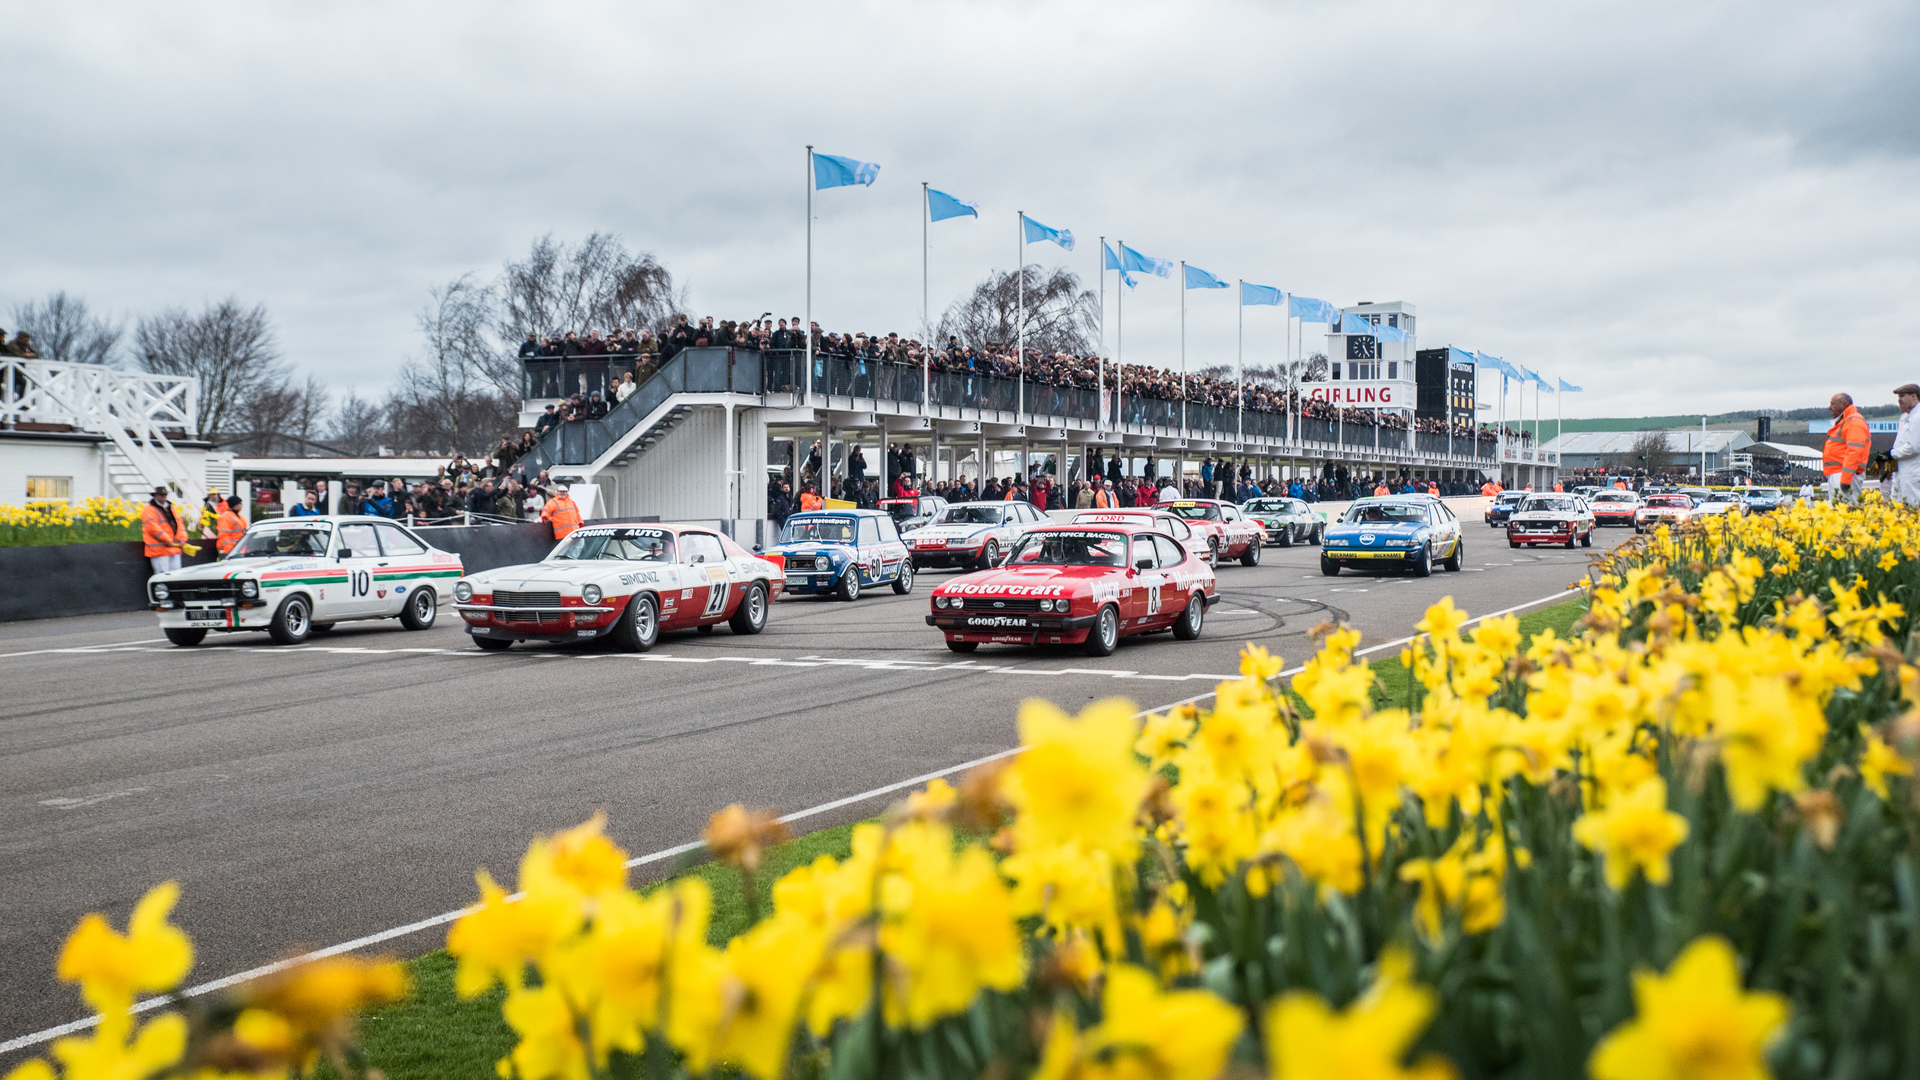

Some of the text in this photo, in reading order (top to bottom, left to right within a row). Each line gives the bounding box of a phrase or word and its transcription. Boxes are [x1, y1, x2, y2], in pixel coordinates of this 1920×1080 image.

[1311, 388, 1391, 402] GIRLING
[923, 418, 929, 427] 2
[973, 422, 979, 431] 3
[1018, 426, 1024, 435] 4
[1060, 429, 1065, 437] 5
[1098, 432, 1103, 440] 6
[577, 529, 663, 538] THINK AUTO
[1086, 532, 1121, 540] RACING
[740, 561, 770, 574] SIMONIZ
[872, 558, 880, 578] 60
[351, 569, 370, 597] 10
[619, 571, 660, 585] SIMONIZ
[944, 583, 1065, 596] Motorcraft
[708, 582, 727, 612] 21
[1151, 586, 1157, 613] 8
